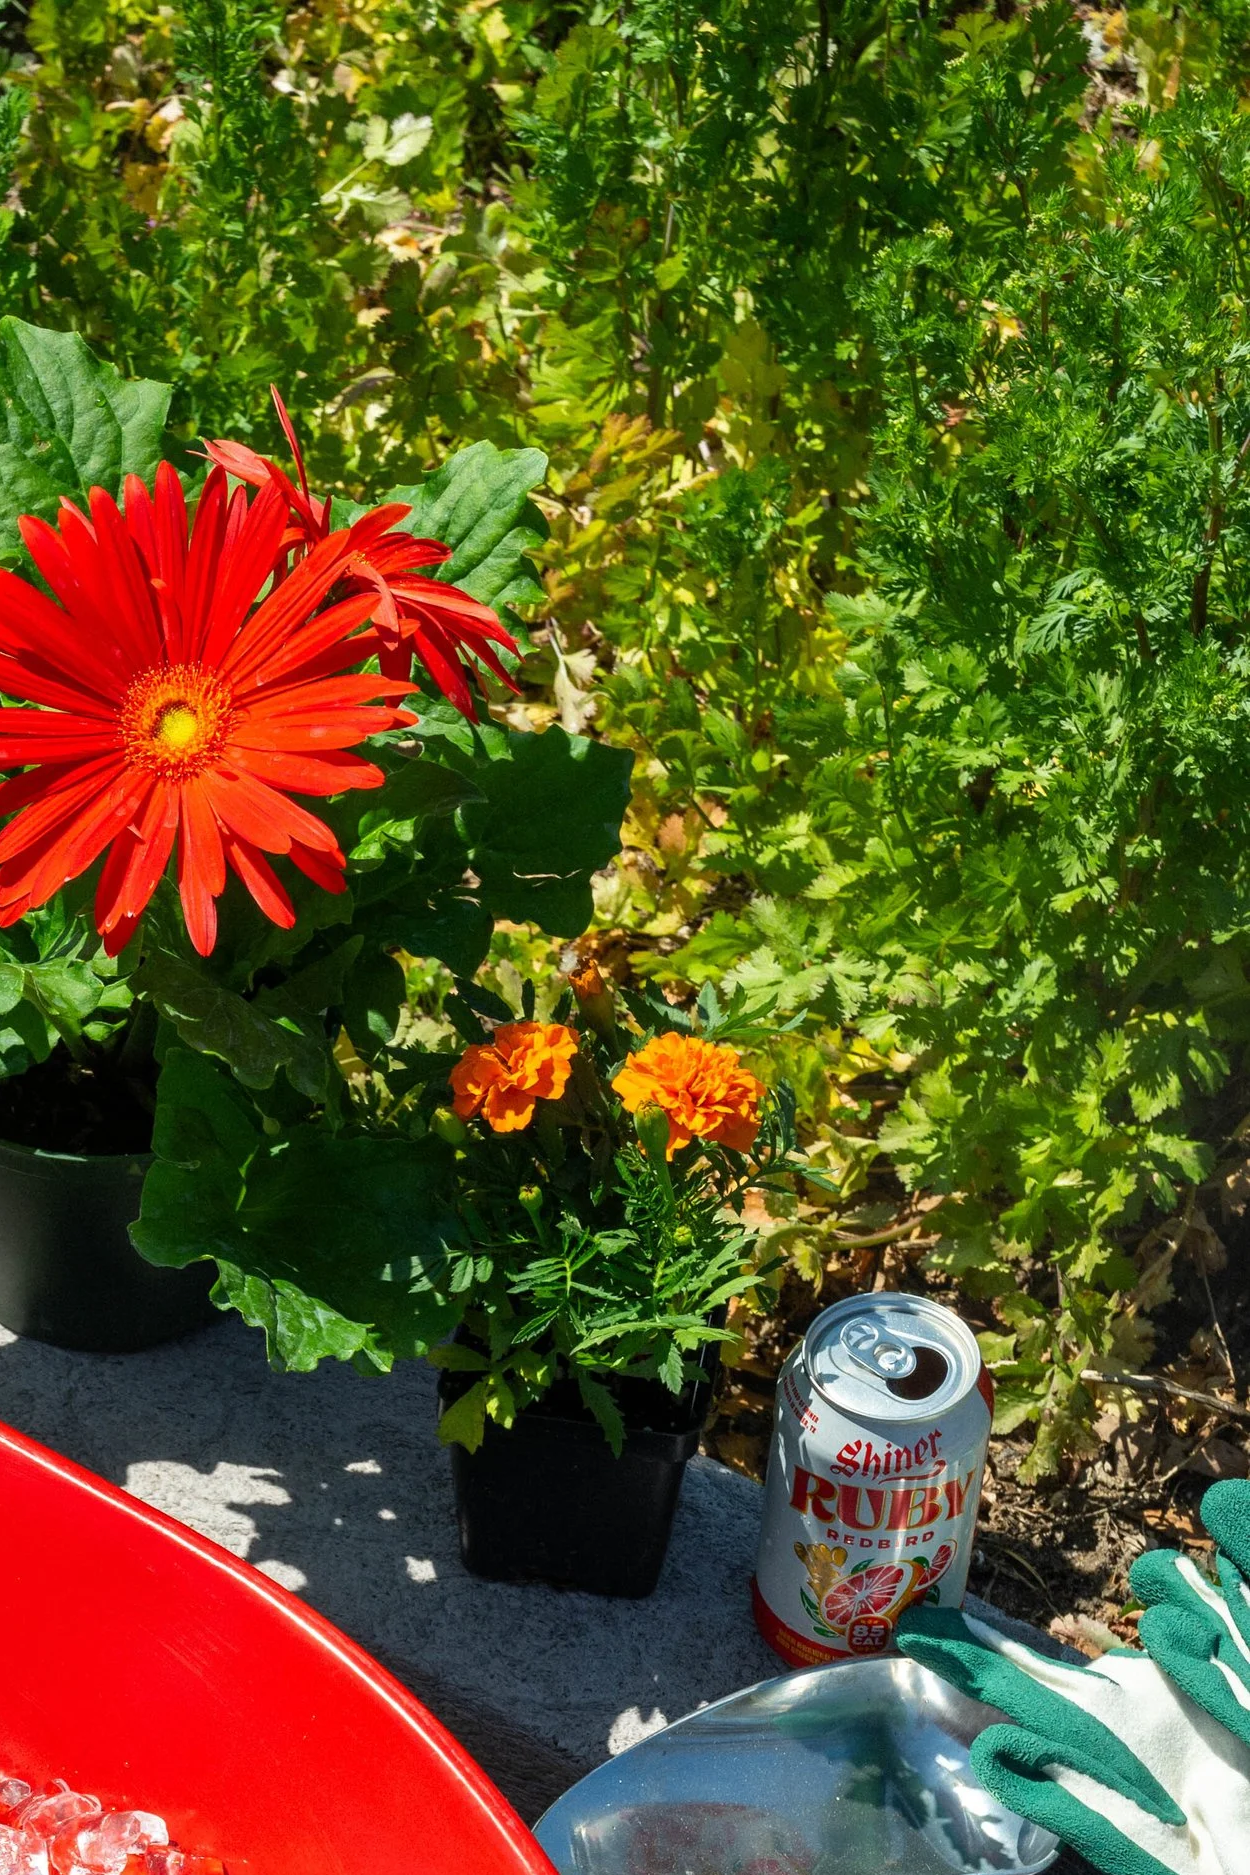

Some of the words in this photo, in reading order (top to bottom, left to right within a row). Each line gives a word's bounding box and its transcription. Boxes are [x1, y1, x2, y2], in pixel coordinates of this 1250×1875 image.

[830, 1428, 943, 1481] Shiner
[790, 1463, 977, 1532] RUBY
[826, 1527, 935, 1550] REDBIRD
[852, 1624, 885, 1638] 85
[852, 1636, 884, 1646] CAL
